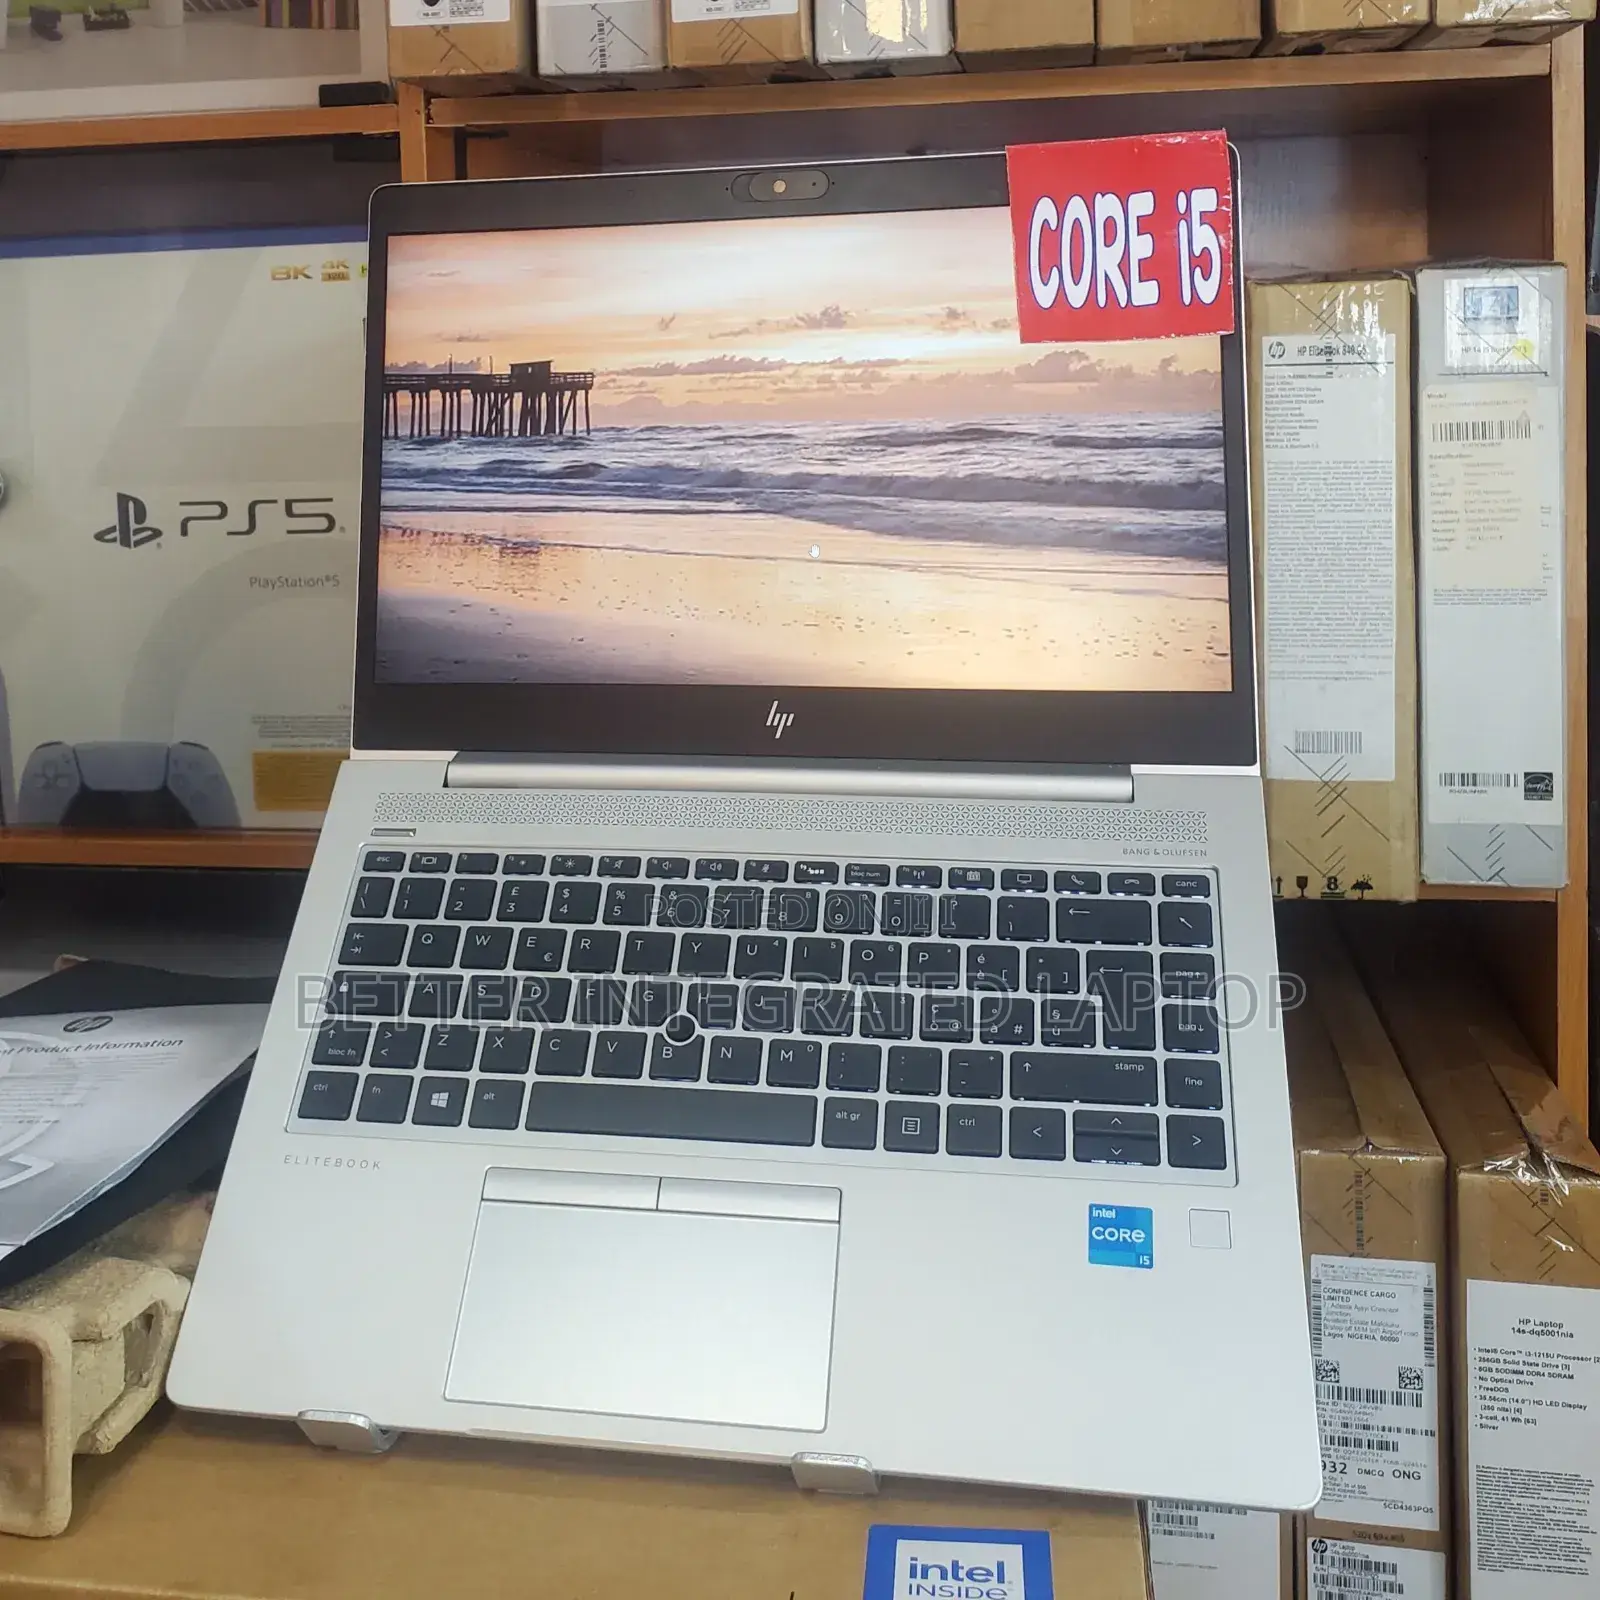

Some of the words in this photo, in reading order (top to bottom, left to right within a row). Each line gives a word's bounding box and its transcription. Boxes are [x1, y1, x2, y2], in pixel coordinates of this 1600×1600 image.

[1029, 190, 1160, 310] CORE
[1176, 187, 1222, 306] i5
[179, 497, 336, 537] PS5
[1122, 848, 1151, 856] BANG
[510, 886, 519, 896] £
[562, 888, 570, 899] $
[615, 890, 626, 900] %
[454, 901, 464, 911] 2
[507, 902, 516, 913] 3
[559, 904, 569, 914] 4
[612, 905, 622, 916] 5
[667, 907, 676, 917] 6
[722, 908, 731, 919] 7
[778, 911, 788, 922] 8
[834, 913, 843, 924] 9
[422, 933, 433, 945] Q
[475, 935, 491, 946] W
[526, 936, 537, 947] E
[580, 938, 591, 950] R
[635, 940, 644, 951] T
[691, 941, 702, 953] Y
[747, 944, 758, 955] U
[861, 949, 874, 961] O
[919, 952, 929, 963] P
[422, 982, 434, 994] A
[477, 984, 486, 996] S
[530, 986, 542, 998] D
[585, 988, 596, 1000] F
[642, 990, 654, 1002] G
[698, 992, 710, 1004] H
[754, 995, 764, 1007] J
[84, 1038, 184, 1050] Information
[437, 1034, 449, 1046] Z
[493, 1036, 504, 1048] X
[550, 1039, 561, 1050] C
[607, 1041, 618, 1053] V
[662, 1047, 673, 1058] B
[720, 1047, 732, 1058] N
[780, 1050, 793, 1062] M
[1114, 1062, 1145, 1072] stamp
[1184, 1077, 1203, 1086] fine
[313, 1083, 329, 1092] ctrl
[372, 1085, 381, 1094] fn
[483, 1091, 495, 1100] alt
[835, 1110, 848, 1120] alt
[850, 1111, 861, 1121] gr
[959, 1117, 976, 1126] ctrl
[284, 1155, 382, 1170] ELITEBOOK
[1092, 1207, 1116, 1219] intel
[1323, 1287, 1368, 1297] CONFIDENCE
[1370, 1291, 1397, 1299] CARGO
[1323, 1295, 1351, 1303] LIMITED
[1518, 1318, 1531, 1326] HP
[1533, 1319, 1564, 1329] Laptop
[1556, 1353, 1592, 1362] Processor
[1502, 1358, 1520, 1366] Solid
[1522, 1360, 1540, 1368] State
[1541, 1361, 1559, 1369] Drive
[1526, 1369, 1546, 1377] DDR4
[1547, 1371, 1574, 1380] SDRAM
[1490, 1377, 1515, 1385] Optical
[1516, 1378, 1534, 1386] Drive
[1478, 1385, 1510, 1394] FreeDOS
[1545, 1400, 1560, 1408] LED
[1561, 1402, 1588, 1411] Display
[1479, 1423, 1499, 1431] Silver
[1357, 1467, 1385, 1477] DMCQ
[1392, 1469, 1422, 1480] ONG
[909, 1556, 1006, 1584] intel
